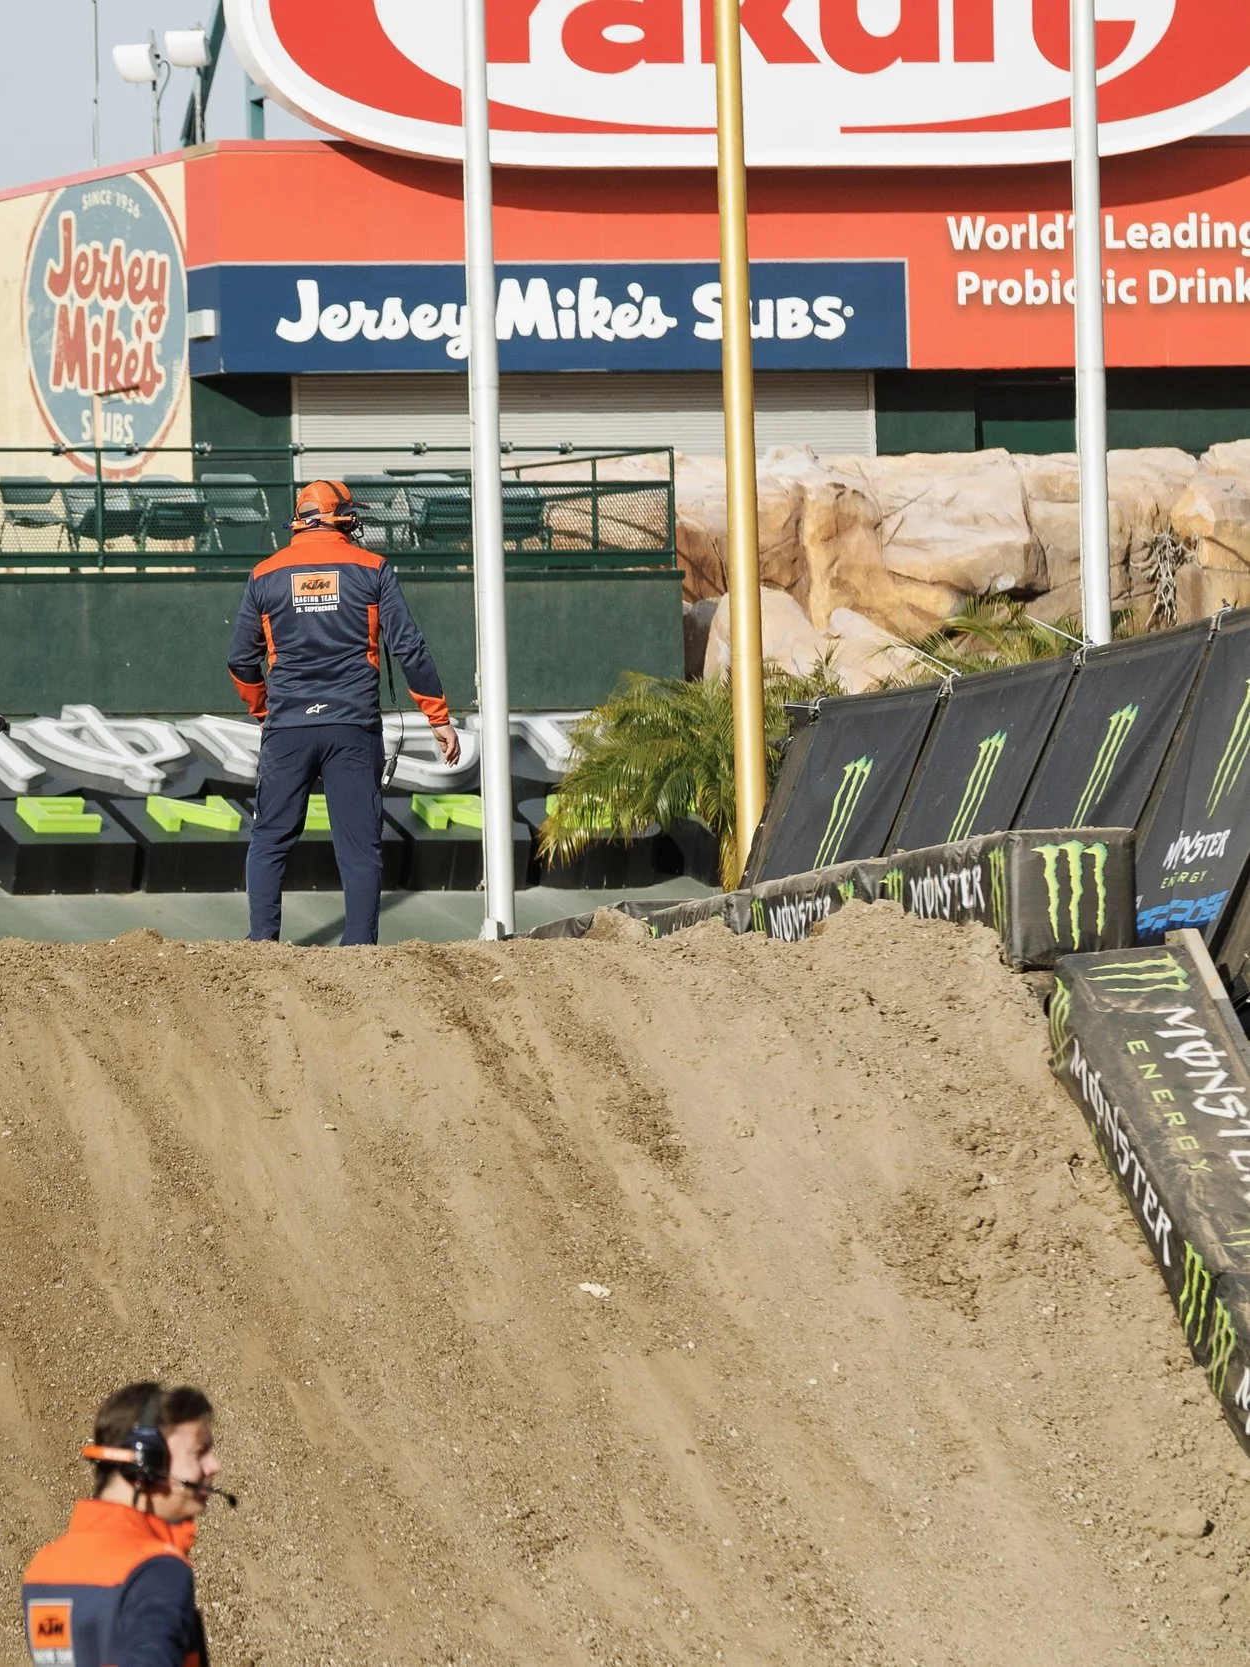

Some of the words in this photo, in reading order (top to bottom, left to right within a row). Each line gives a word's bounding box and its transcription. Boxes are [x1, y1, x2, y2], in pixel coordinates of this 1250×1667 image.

[81, 189, 112, 211] SINCE
[116, 192, 141, 219] 1956
[946, 212, 1076, 251] World'
[46, 214, 169, 336] Jersey
[957, 268, 1138, 306] Probioic
[275, 279, 472, 360] Jersey
[495, 277, 678, 342] Mike's
[51, 303, 163, 400] Mike's
[294, 595, 319, 604] RACING
[321, 594, 338, 602] TEAM
[300, 578, 331, 591] KTM
[304, 604, 338, 613] SUPERCROSS
[1125, 1038, 1213, 1173] ENERGY
[1069, 1037, 1172, 1267] MONSTER
